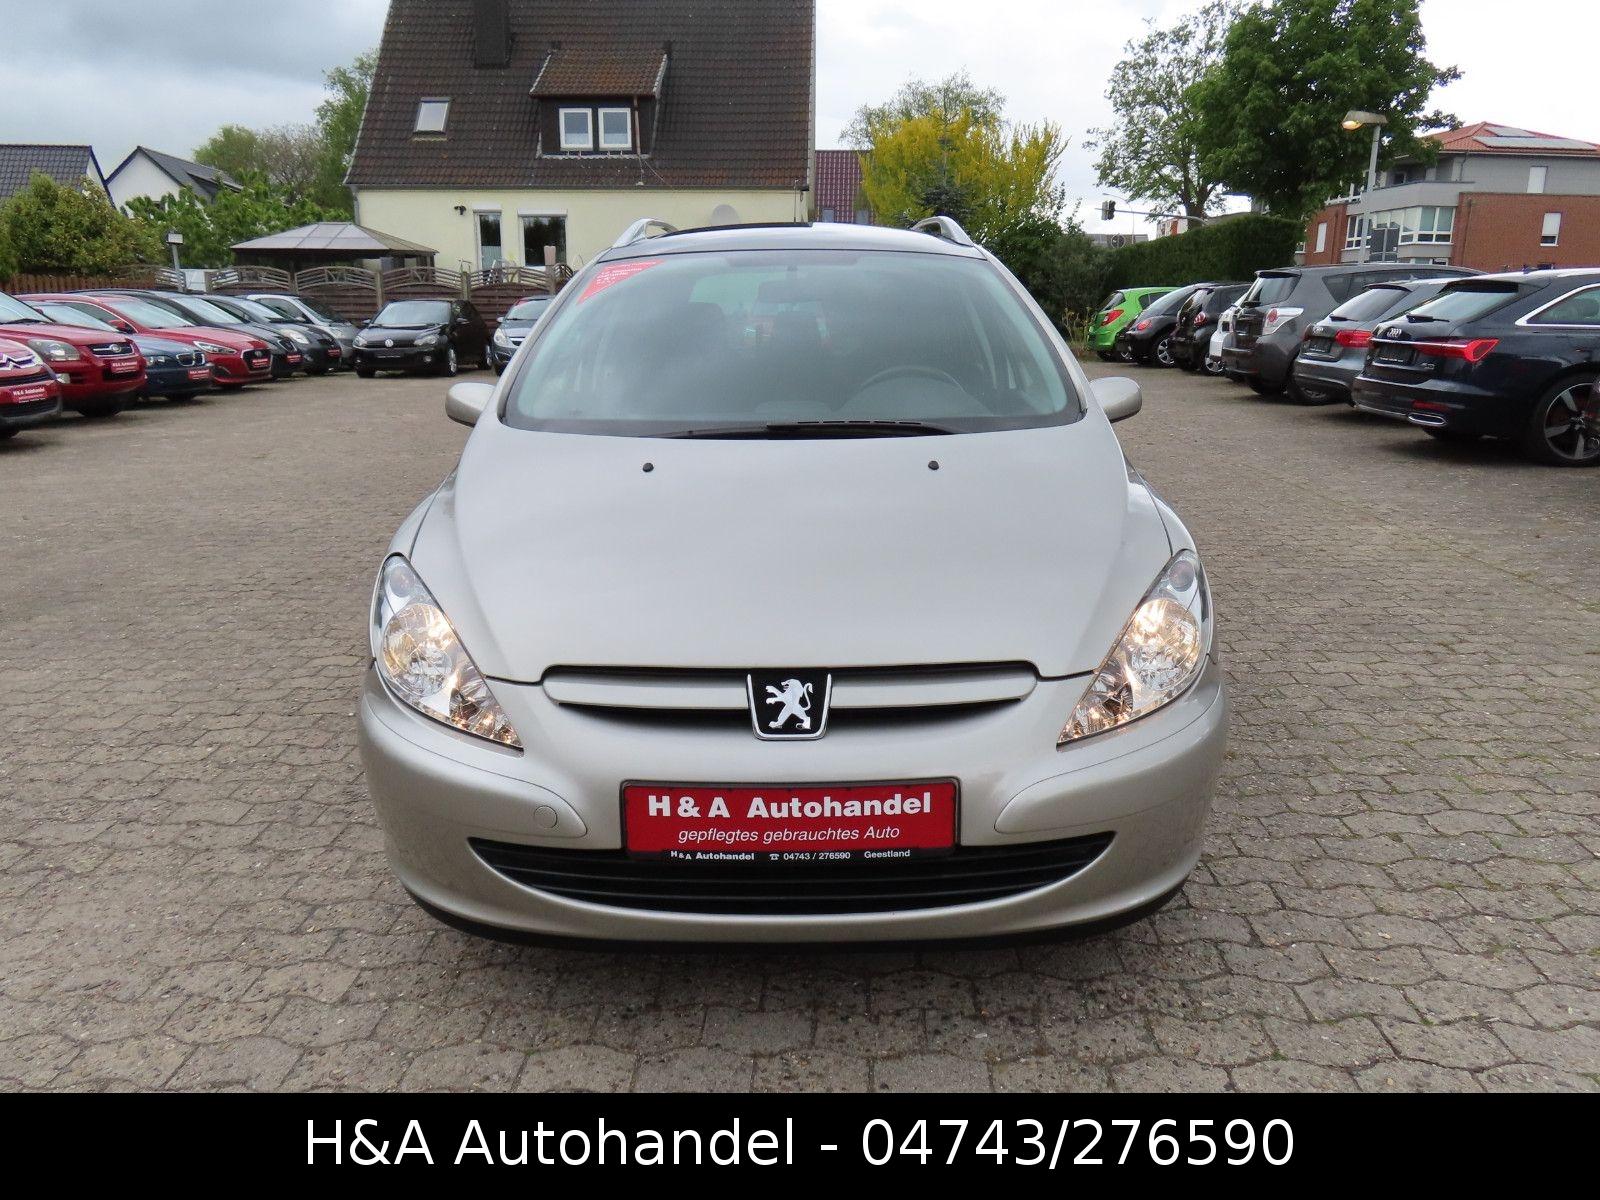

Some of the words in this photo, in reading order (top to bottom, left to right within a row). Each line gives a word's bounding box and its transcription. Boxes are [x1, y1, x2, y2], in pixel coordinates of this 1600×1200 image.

[648, 795, 671, 817] H
[707, 796, 731, 818] A
[747, 791, 932, 819] Autohandel
[678, 827, 759, 845] gepflegtes
[763, 827, 860, 845] gebrauchtes
[863, 826, 900, 840] Auto
[695, 851, 755, 861] Autohandel
[783, 852, 811, 861] 04743
[818, 851, 851, 861] 276590
[864, 849, 911, 859] Geestland
